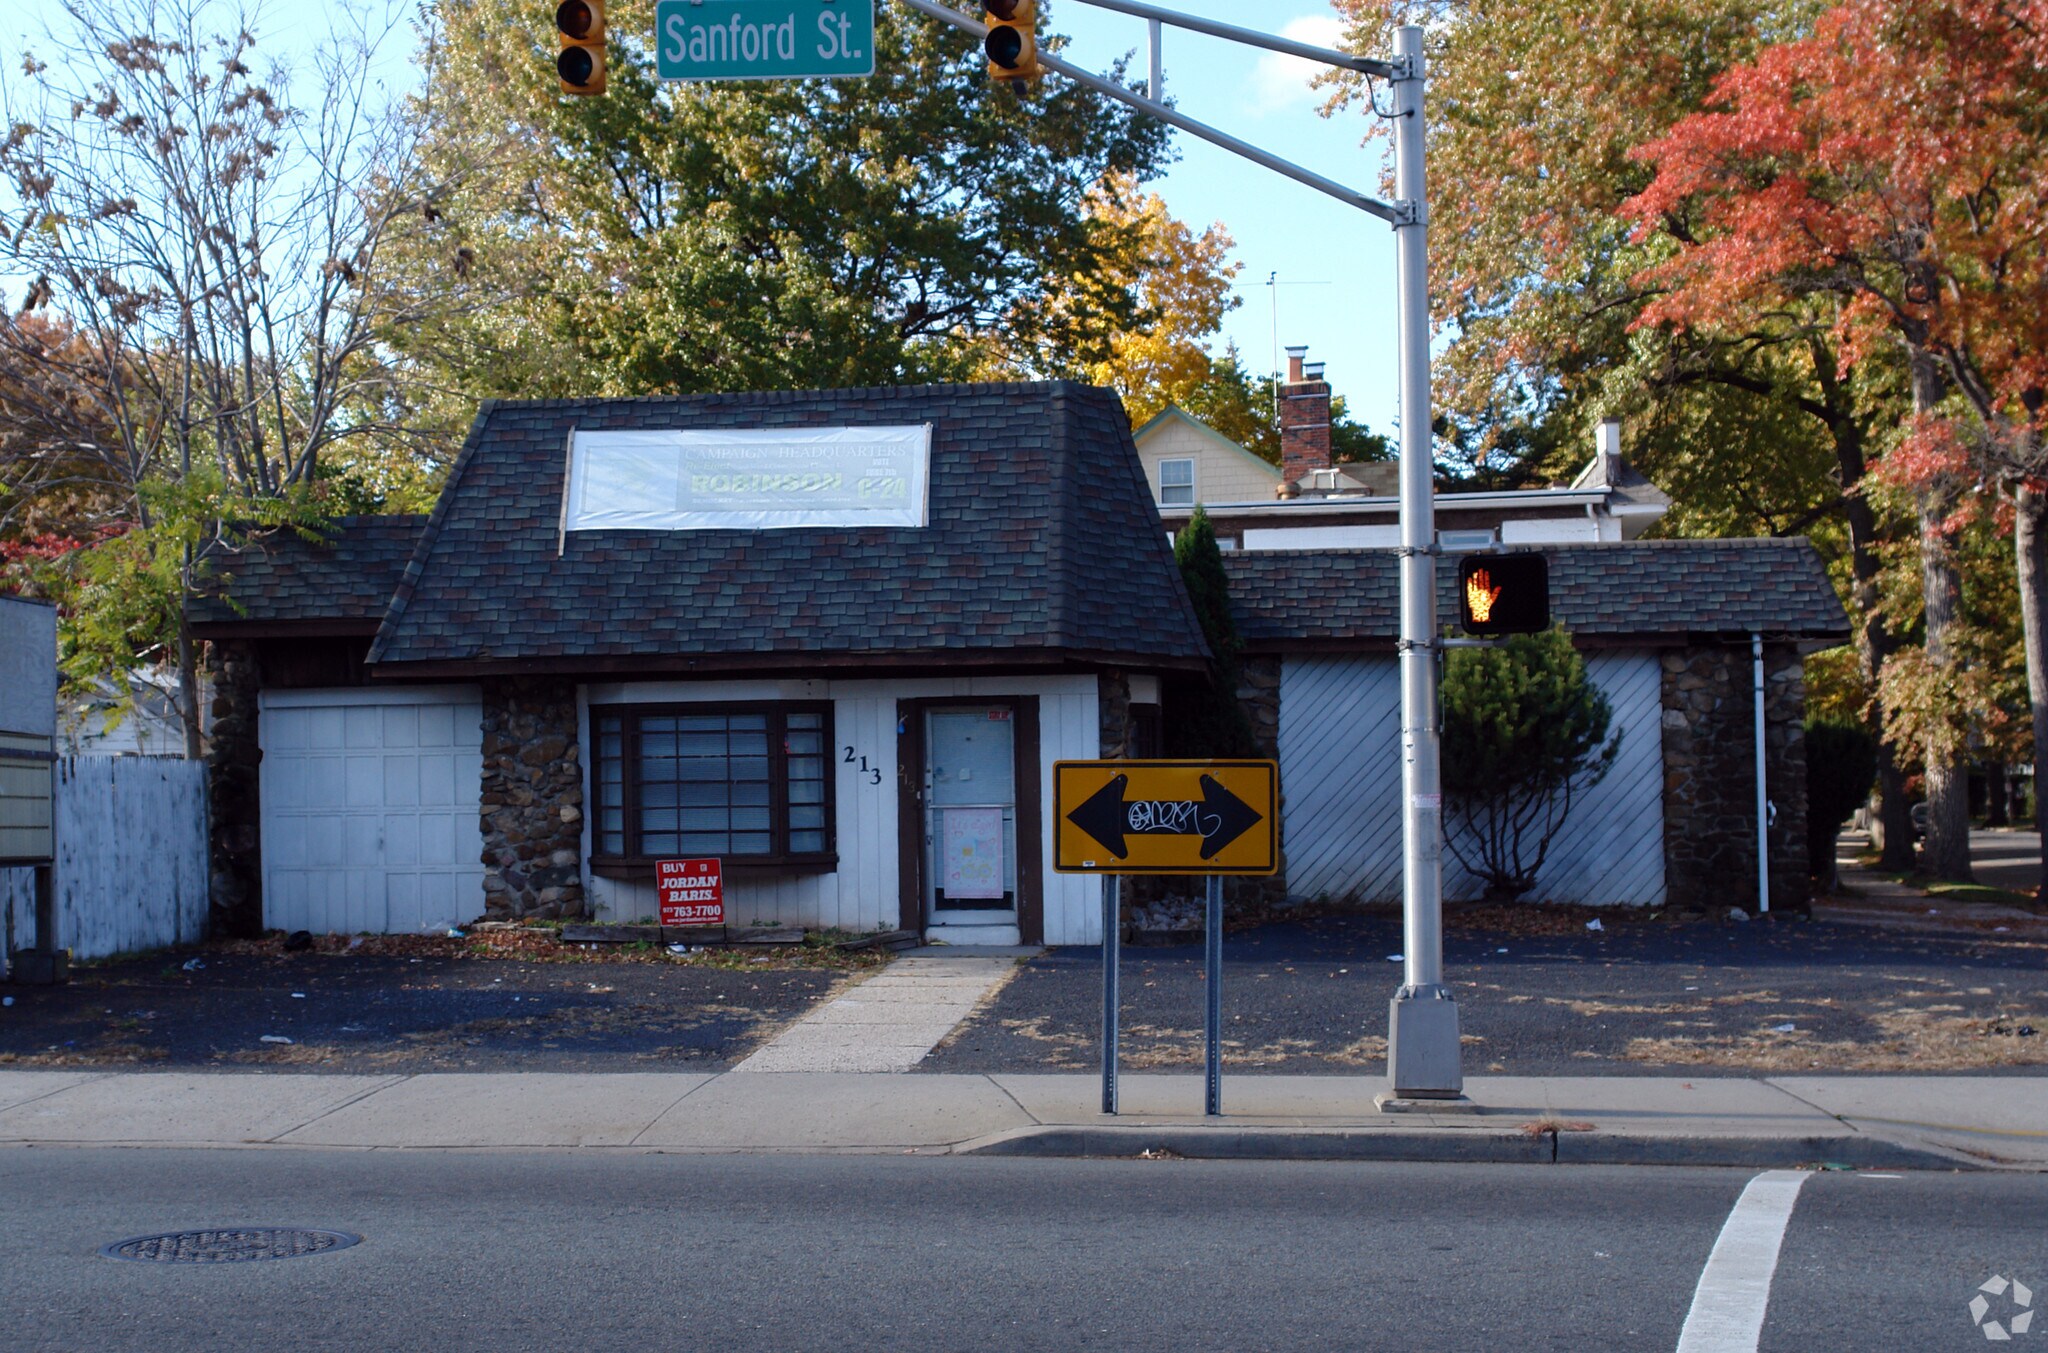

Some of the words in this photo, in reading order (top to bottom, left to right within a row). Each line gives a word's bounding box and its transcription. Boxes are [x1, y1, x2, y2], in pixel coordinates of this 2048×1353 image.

[664, 13, 796, 63] Sanford
[816, 10, 862, 60] St.
[685, 447, 768, 460] CAMPAIGN
[778, 445, 906, 460] HEADQUARTERS
[691, 472, 843, 494] ROBINSON
[843, 746, 882, 785] 213
[662, 863, 686, 873] BUY
[661, 876, 718, 889] JORDAN
[668, 890, 713, 902] BARIS
[673, 905, 721, 917] 763-7700
